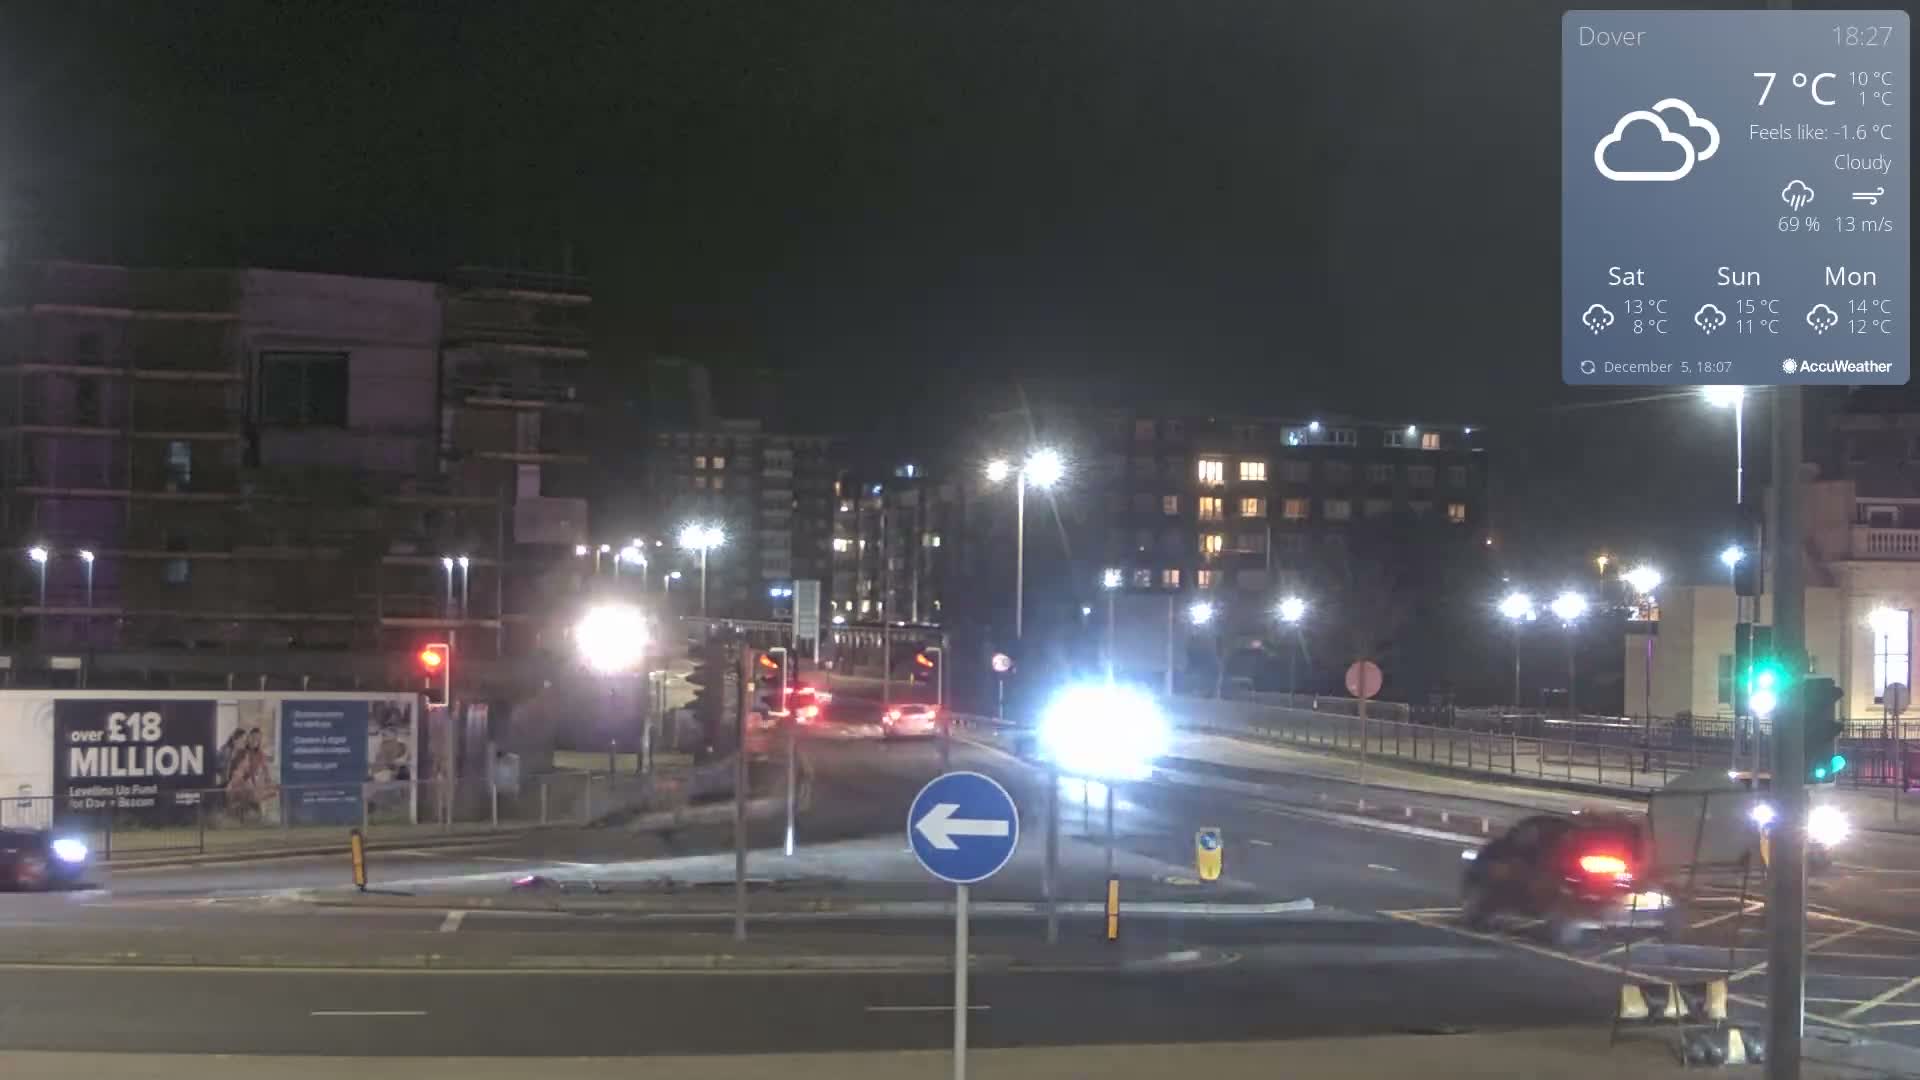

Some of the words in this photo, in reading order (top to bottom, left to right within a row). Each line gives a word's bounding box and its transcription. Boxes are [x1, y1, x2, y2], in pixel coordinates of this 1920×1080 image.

[71, 729, 105, 743] over
[107, 711, 162, 743] £18
[69, 744, 205, 778] MILLION
